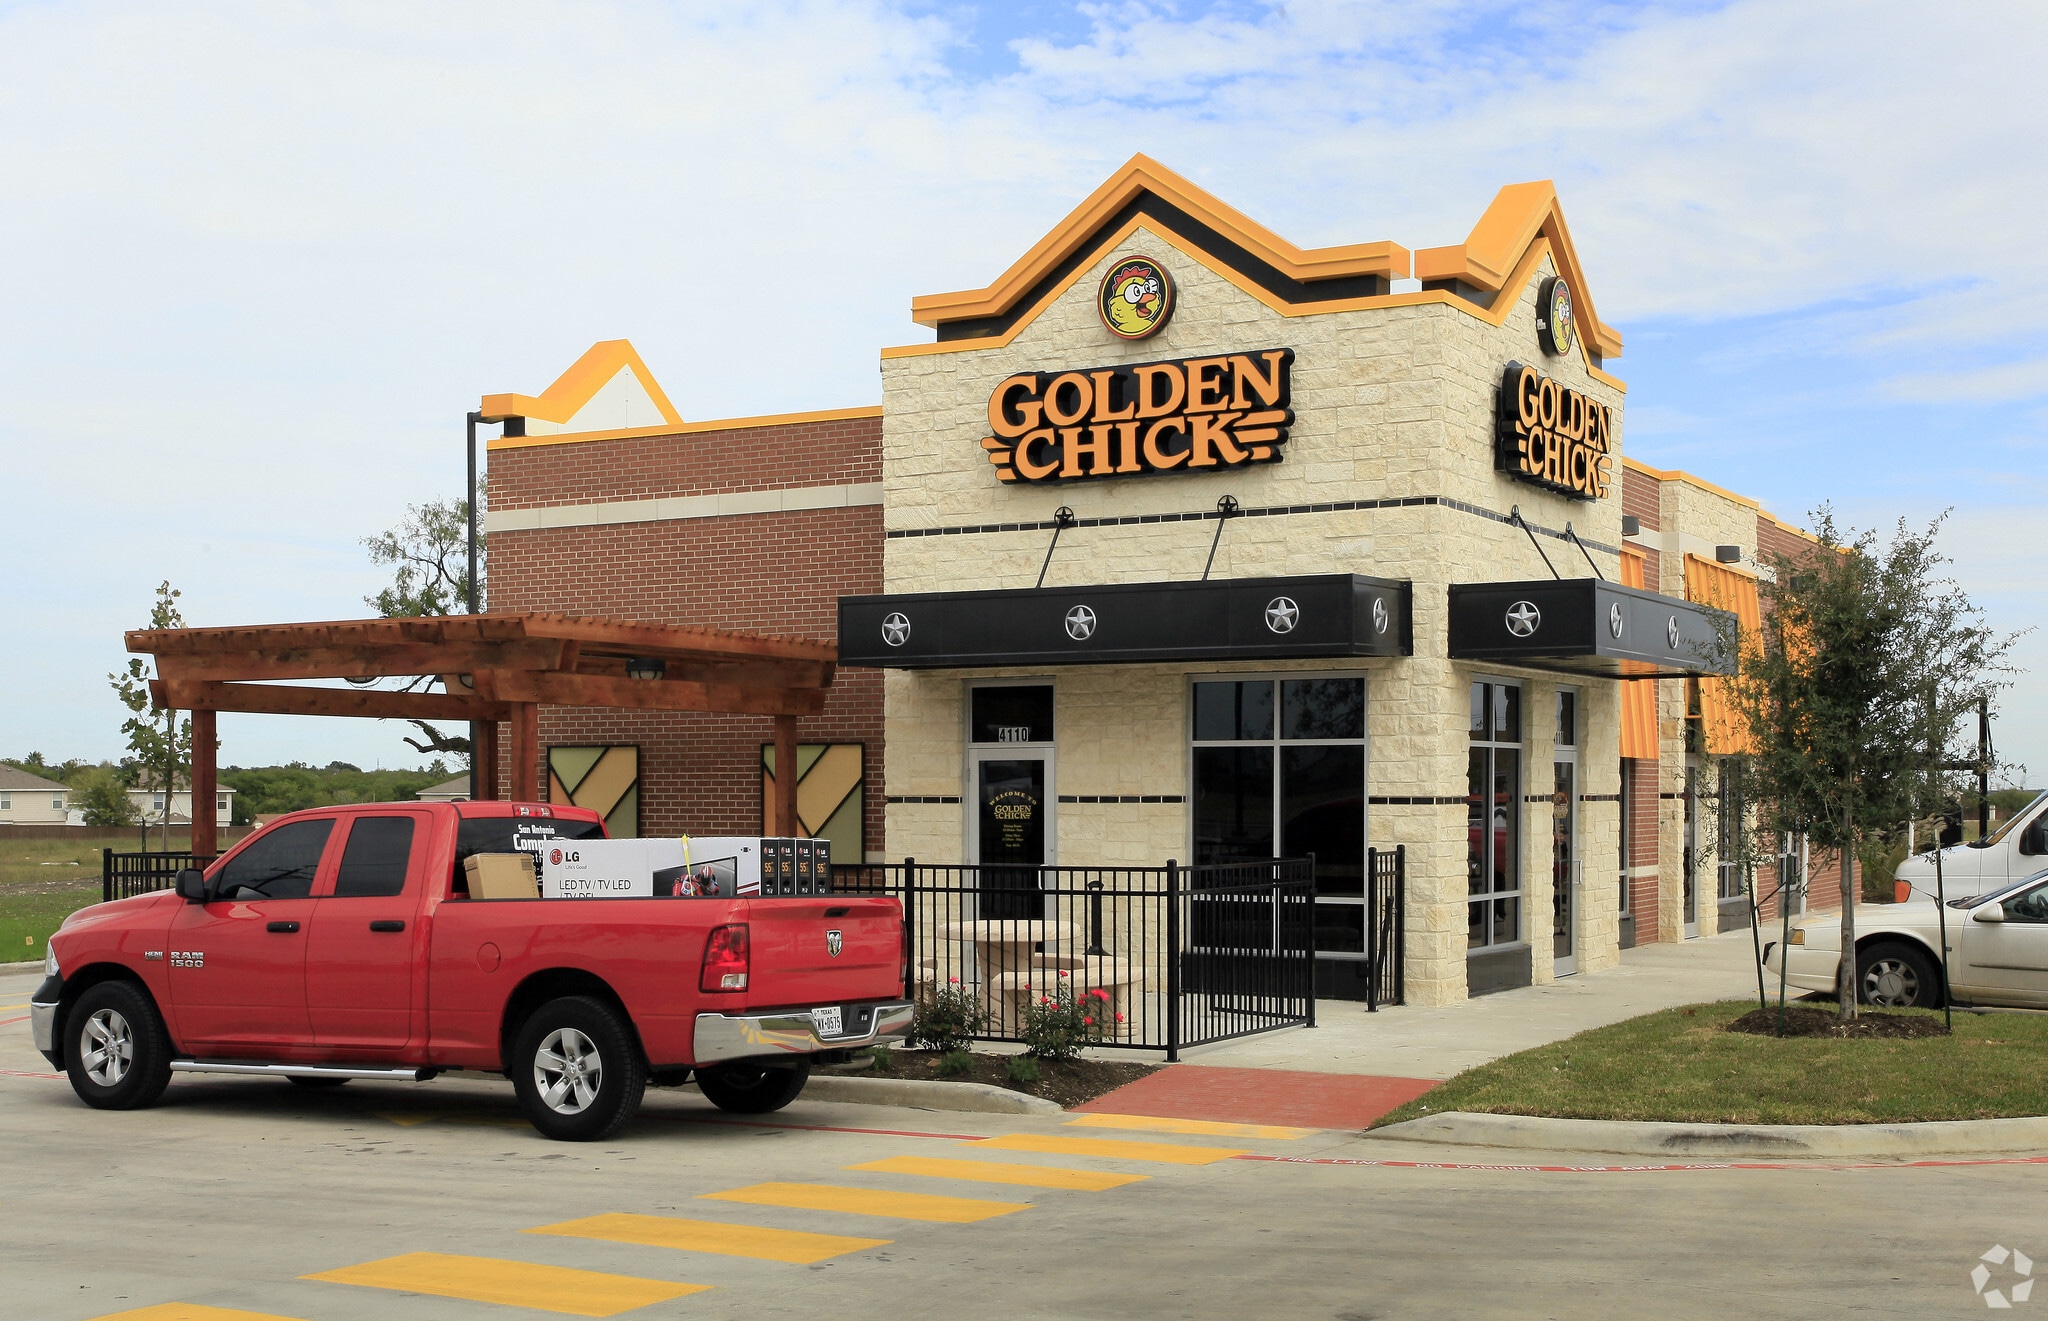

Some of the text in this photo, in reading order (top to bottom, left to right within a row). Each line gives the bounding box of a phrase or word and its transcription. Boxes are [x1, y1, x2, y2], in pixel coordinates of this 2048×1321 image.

[987, 350, 1285, 438] GOLDEN
[1518, 365, 1613, 454] GOLDEN
[1015, 411, 1250, 480] CHICK
[1528, 425, 1604, 498] CHICK
[999, 728, 1028, 742] 4110
[989, 791, 1037, 806] WELCOME TO
[994, 804, 1031, 813] GOLDEN
[517, 824, 556, 835] San Antonio
[513, 834, 546, 854] Comp
[565, 852, 580, 862] LG
[559, 879, 577, 890] LED
[579, 879, 592, 890] TV
[597, 879, 611, 890] TV
[612, 879, 632, 890] LED
[170, 951, 204, 960] RAM
[170, 959, 204, 968] 1500
